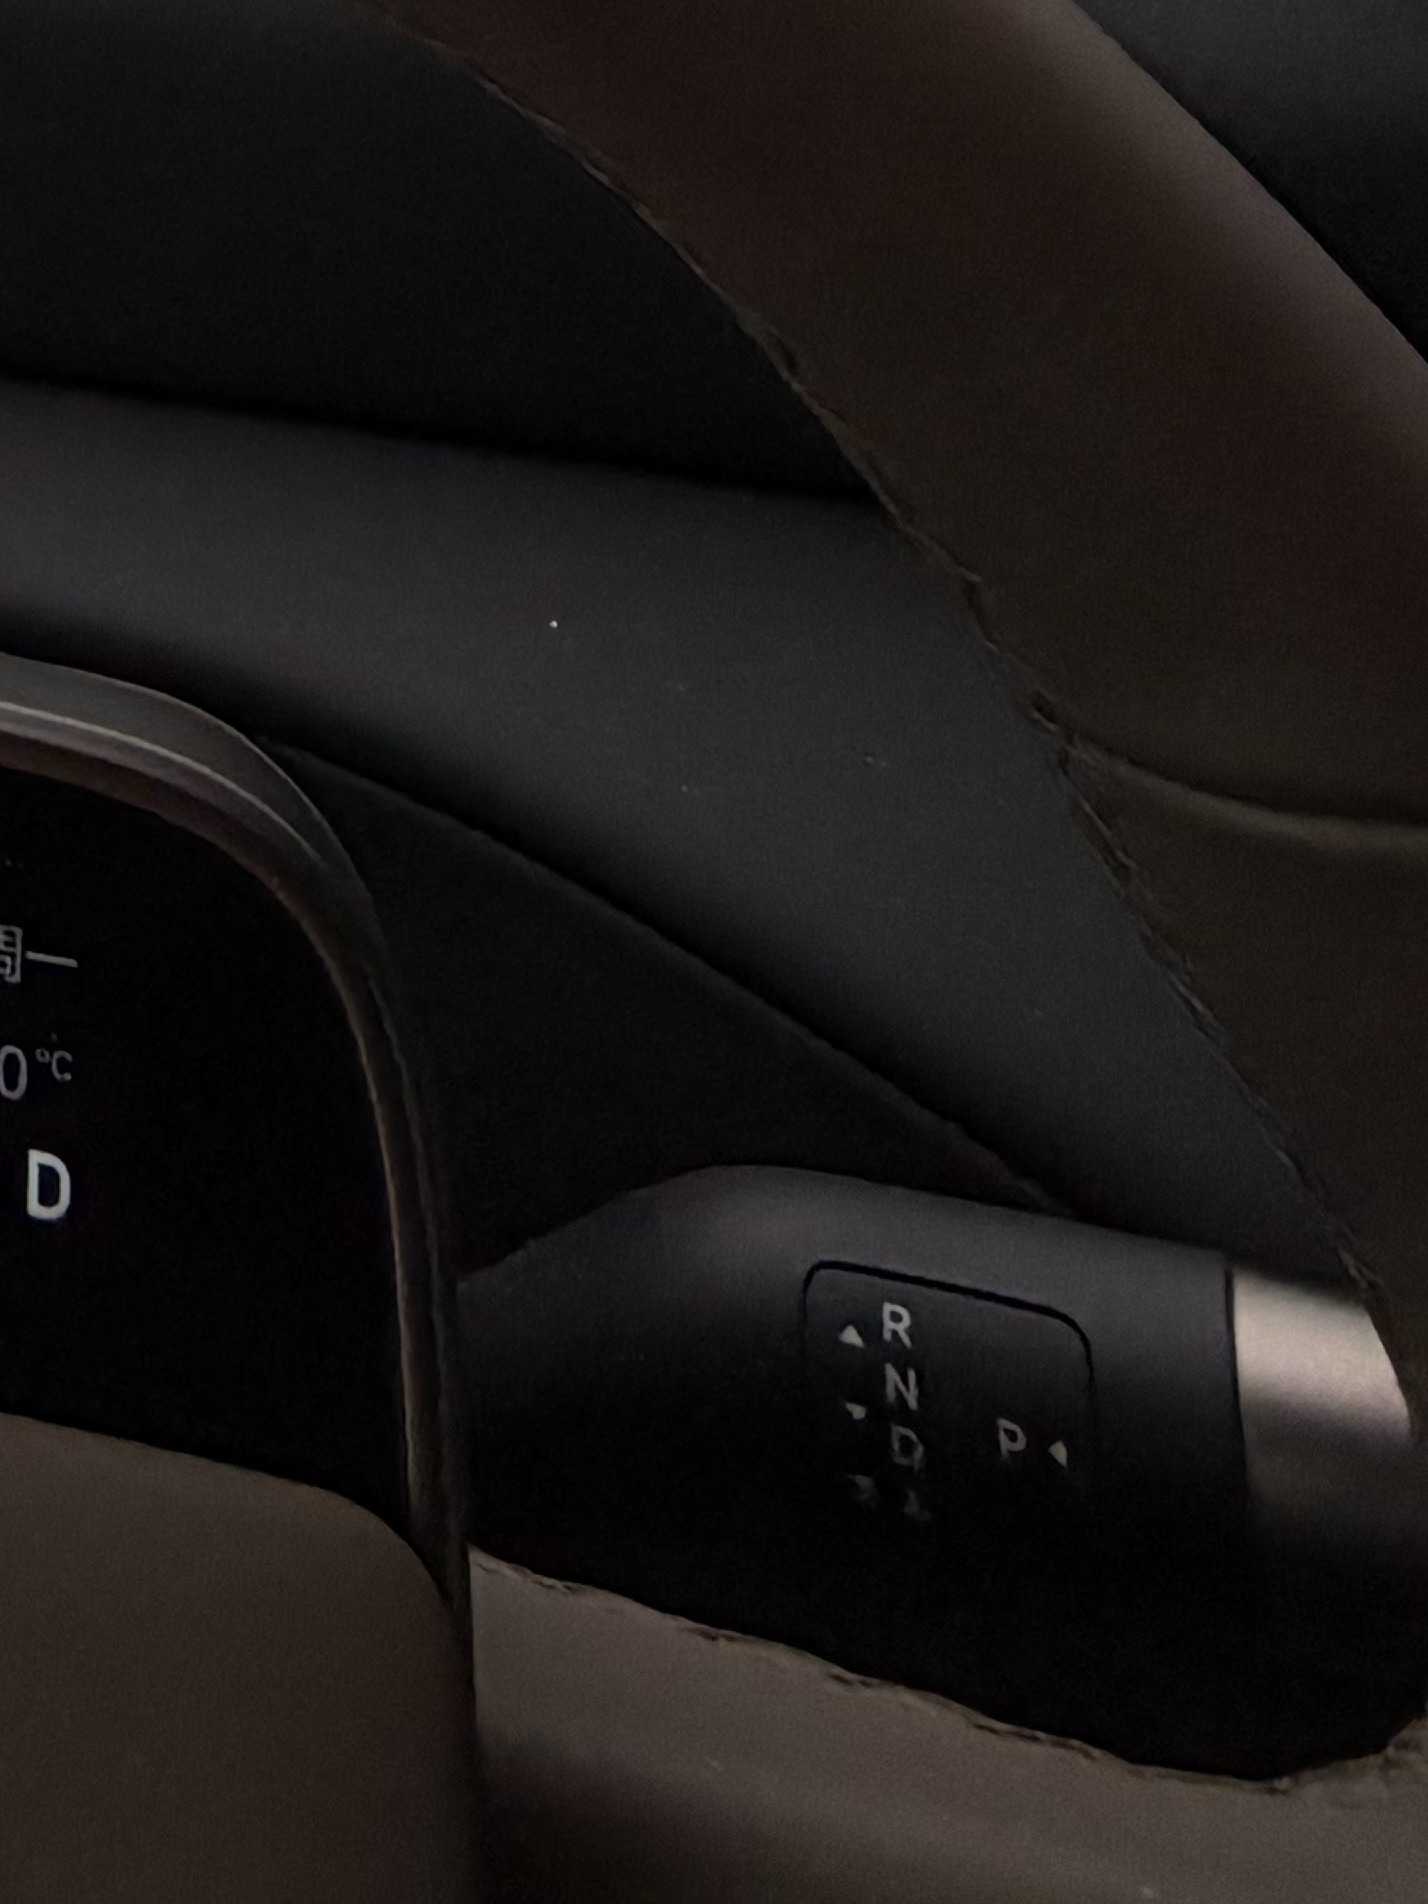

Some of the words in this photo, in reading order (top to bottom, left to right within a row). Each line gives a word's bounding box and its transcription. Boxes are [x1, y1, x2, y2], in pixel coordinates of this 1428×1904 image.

[25, 1148, 73, 1222] D
[881, 1300, 913, 1348] R
[883, 1361, 920, 1412] N
[996, 1417, 1028, 1461] P
